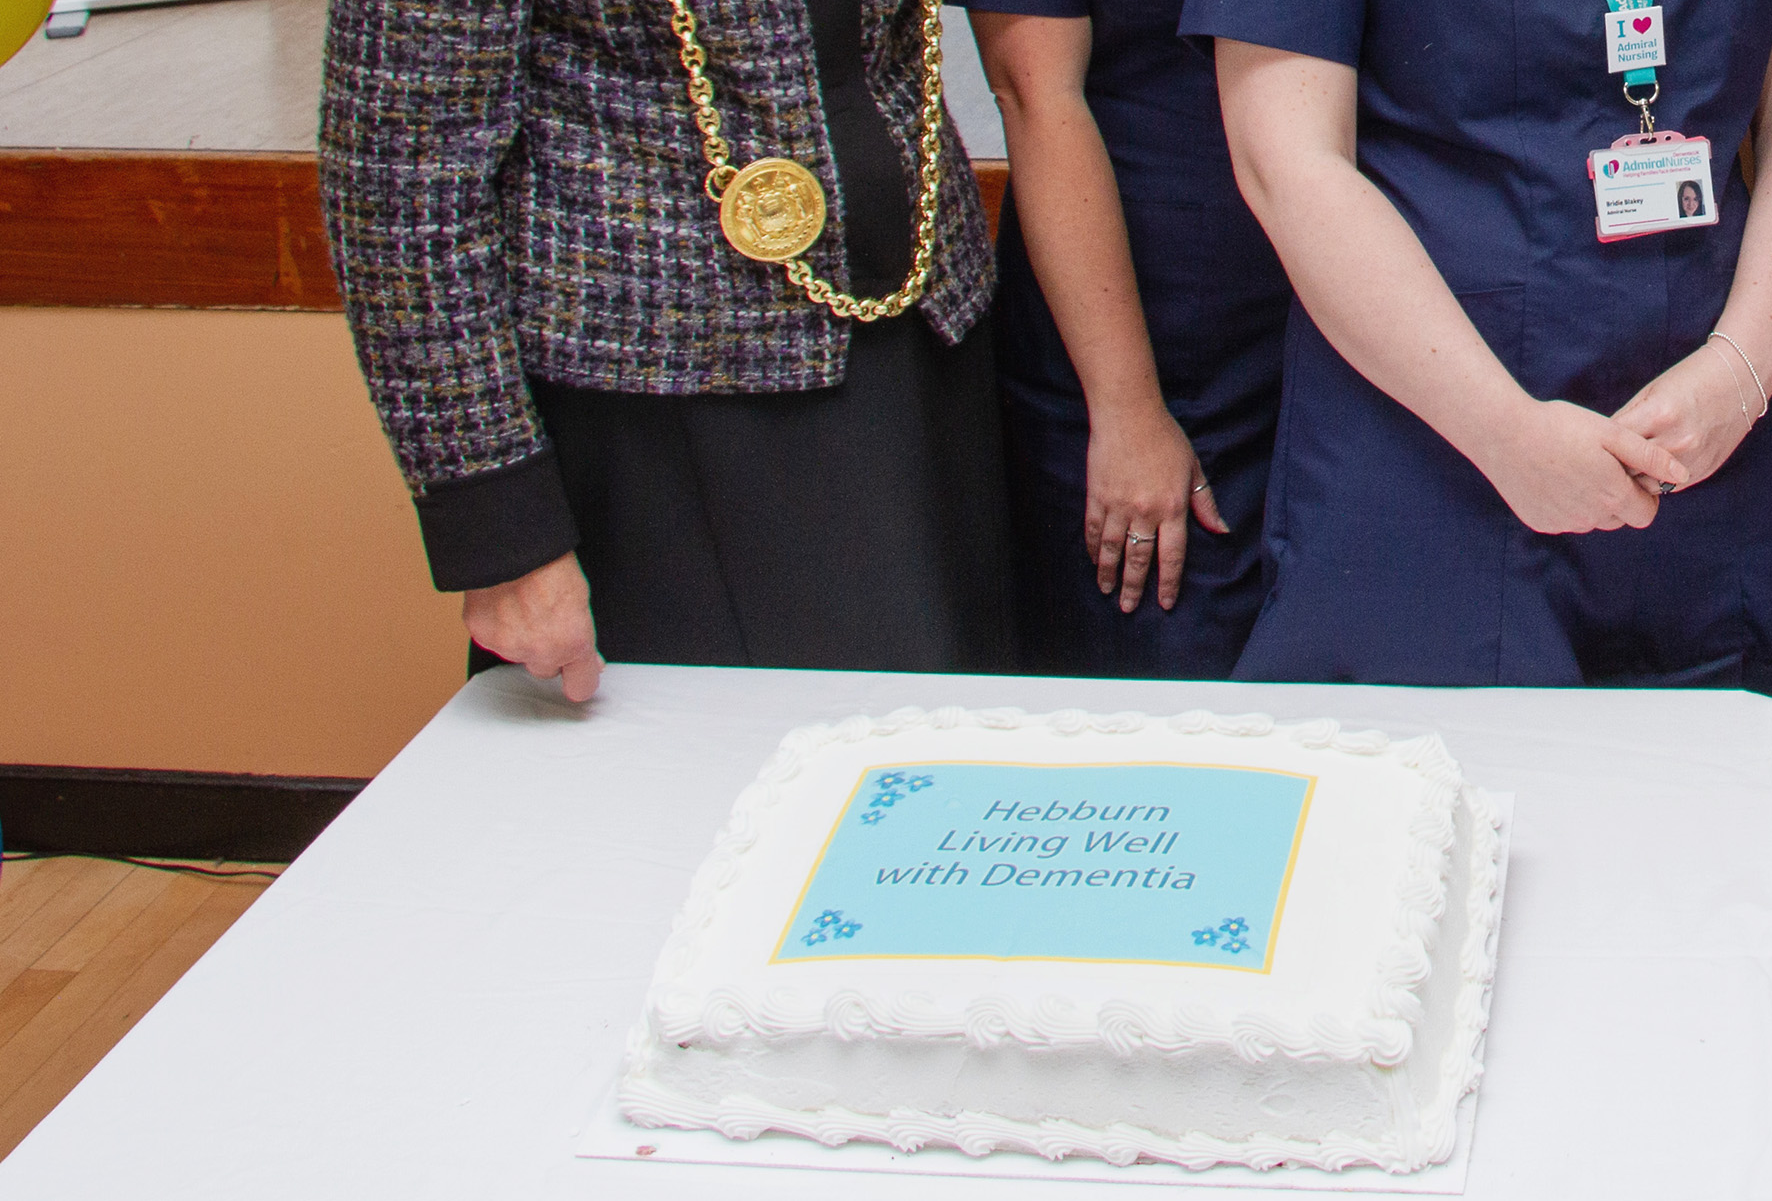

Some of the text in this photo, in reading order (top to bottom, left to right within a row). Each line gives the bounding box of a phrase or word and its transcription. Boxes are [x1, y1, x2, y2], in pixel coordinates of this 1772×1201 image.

[1616, 20, 1626, 38] I
[1617, 38, 1657, 52] Admiral
[1618, 50, 1658, 62] Nursing
[982, 800, 1171, 822] Hebburn
[936, 830, 1180, 859] Living Well
[875, 861, 1197, 890] with Dementia
